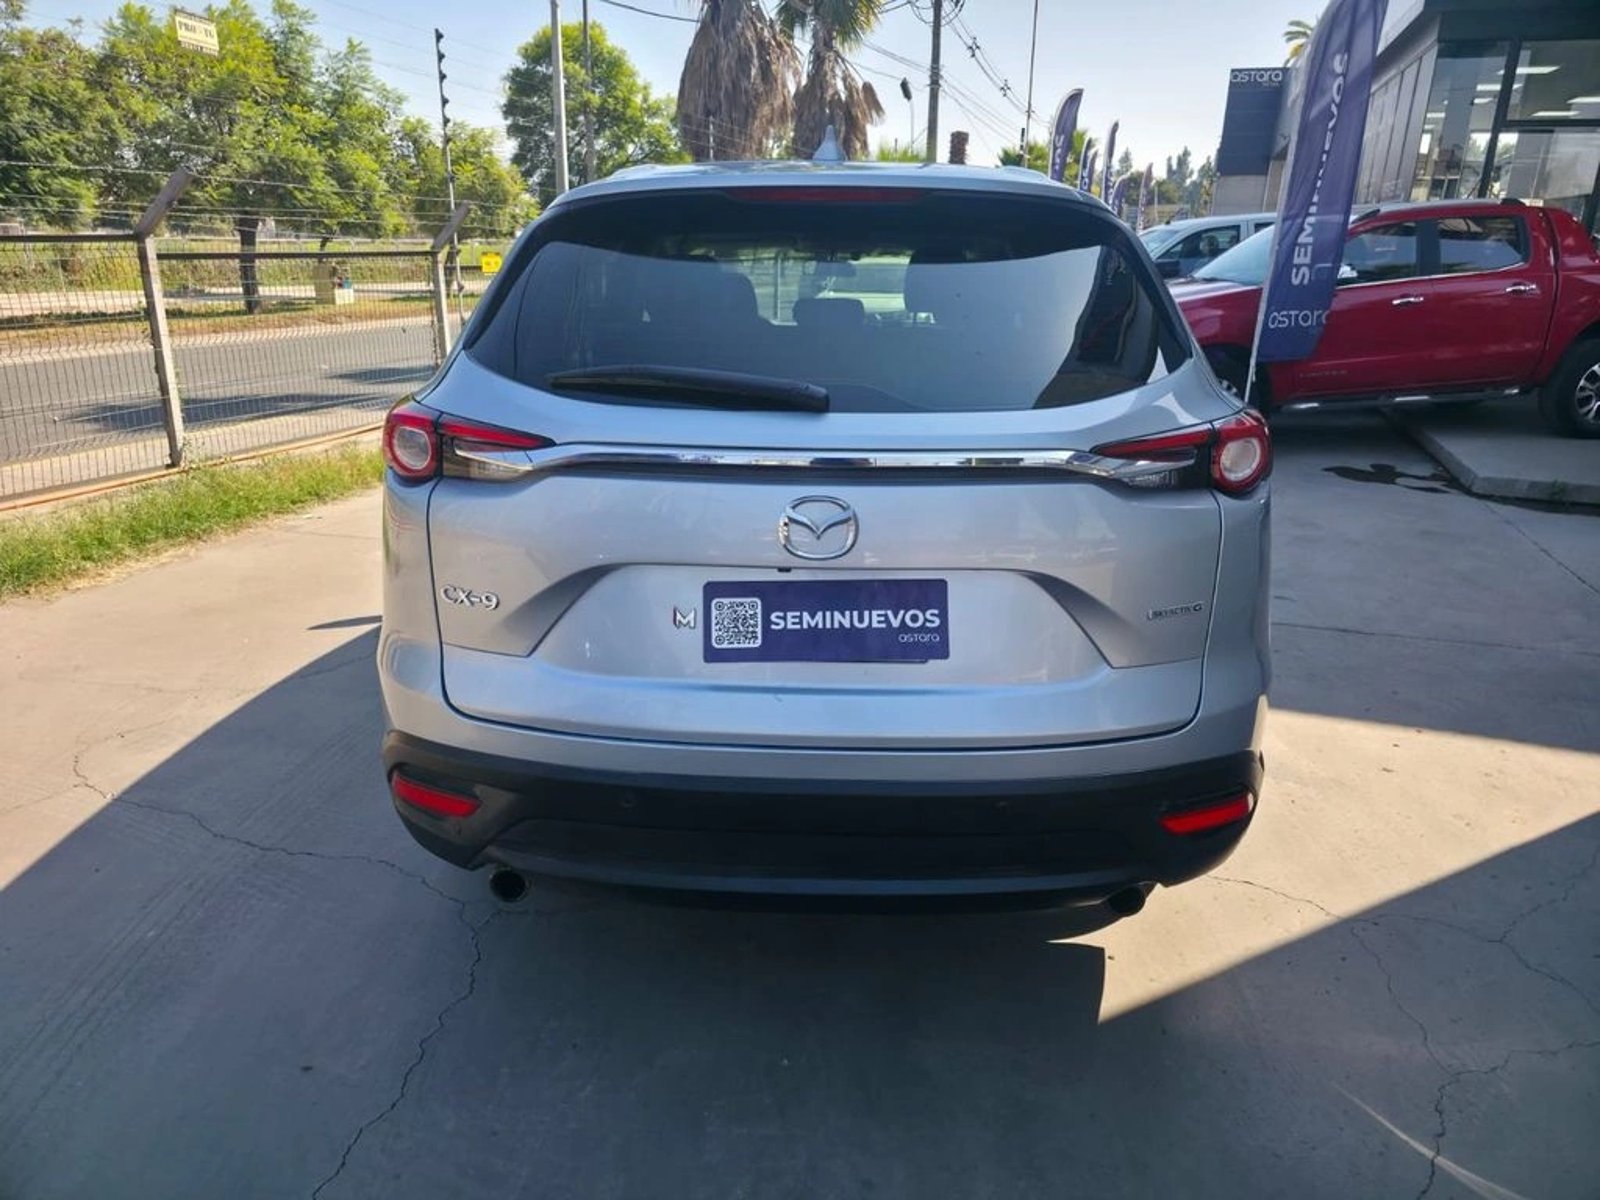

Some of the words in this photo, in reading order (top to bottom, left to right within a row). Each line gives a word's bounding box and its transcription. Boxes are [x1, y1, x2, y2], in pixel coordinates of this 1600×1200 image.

[440, 584, 500, 611] CX-9
[770, 609, 941, 630] SEMINUEVOS
[898, 633, 940, 643] astara
